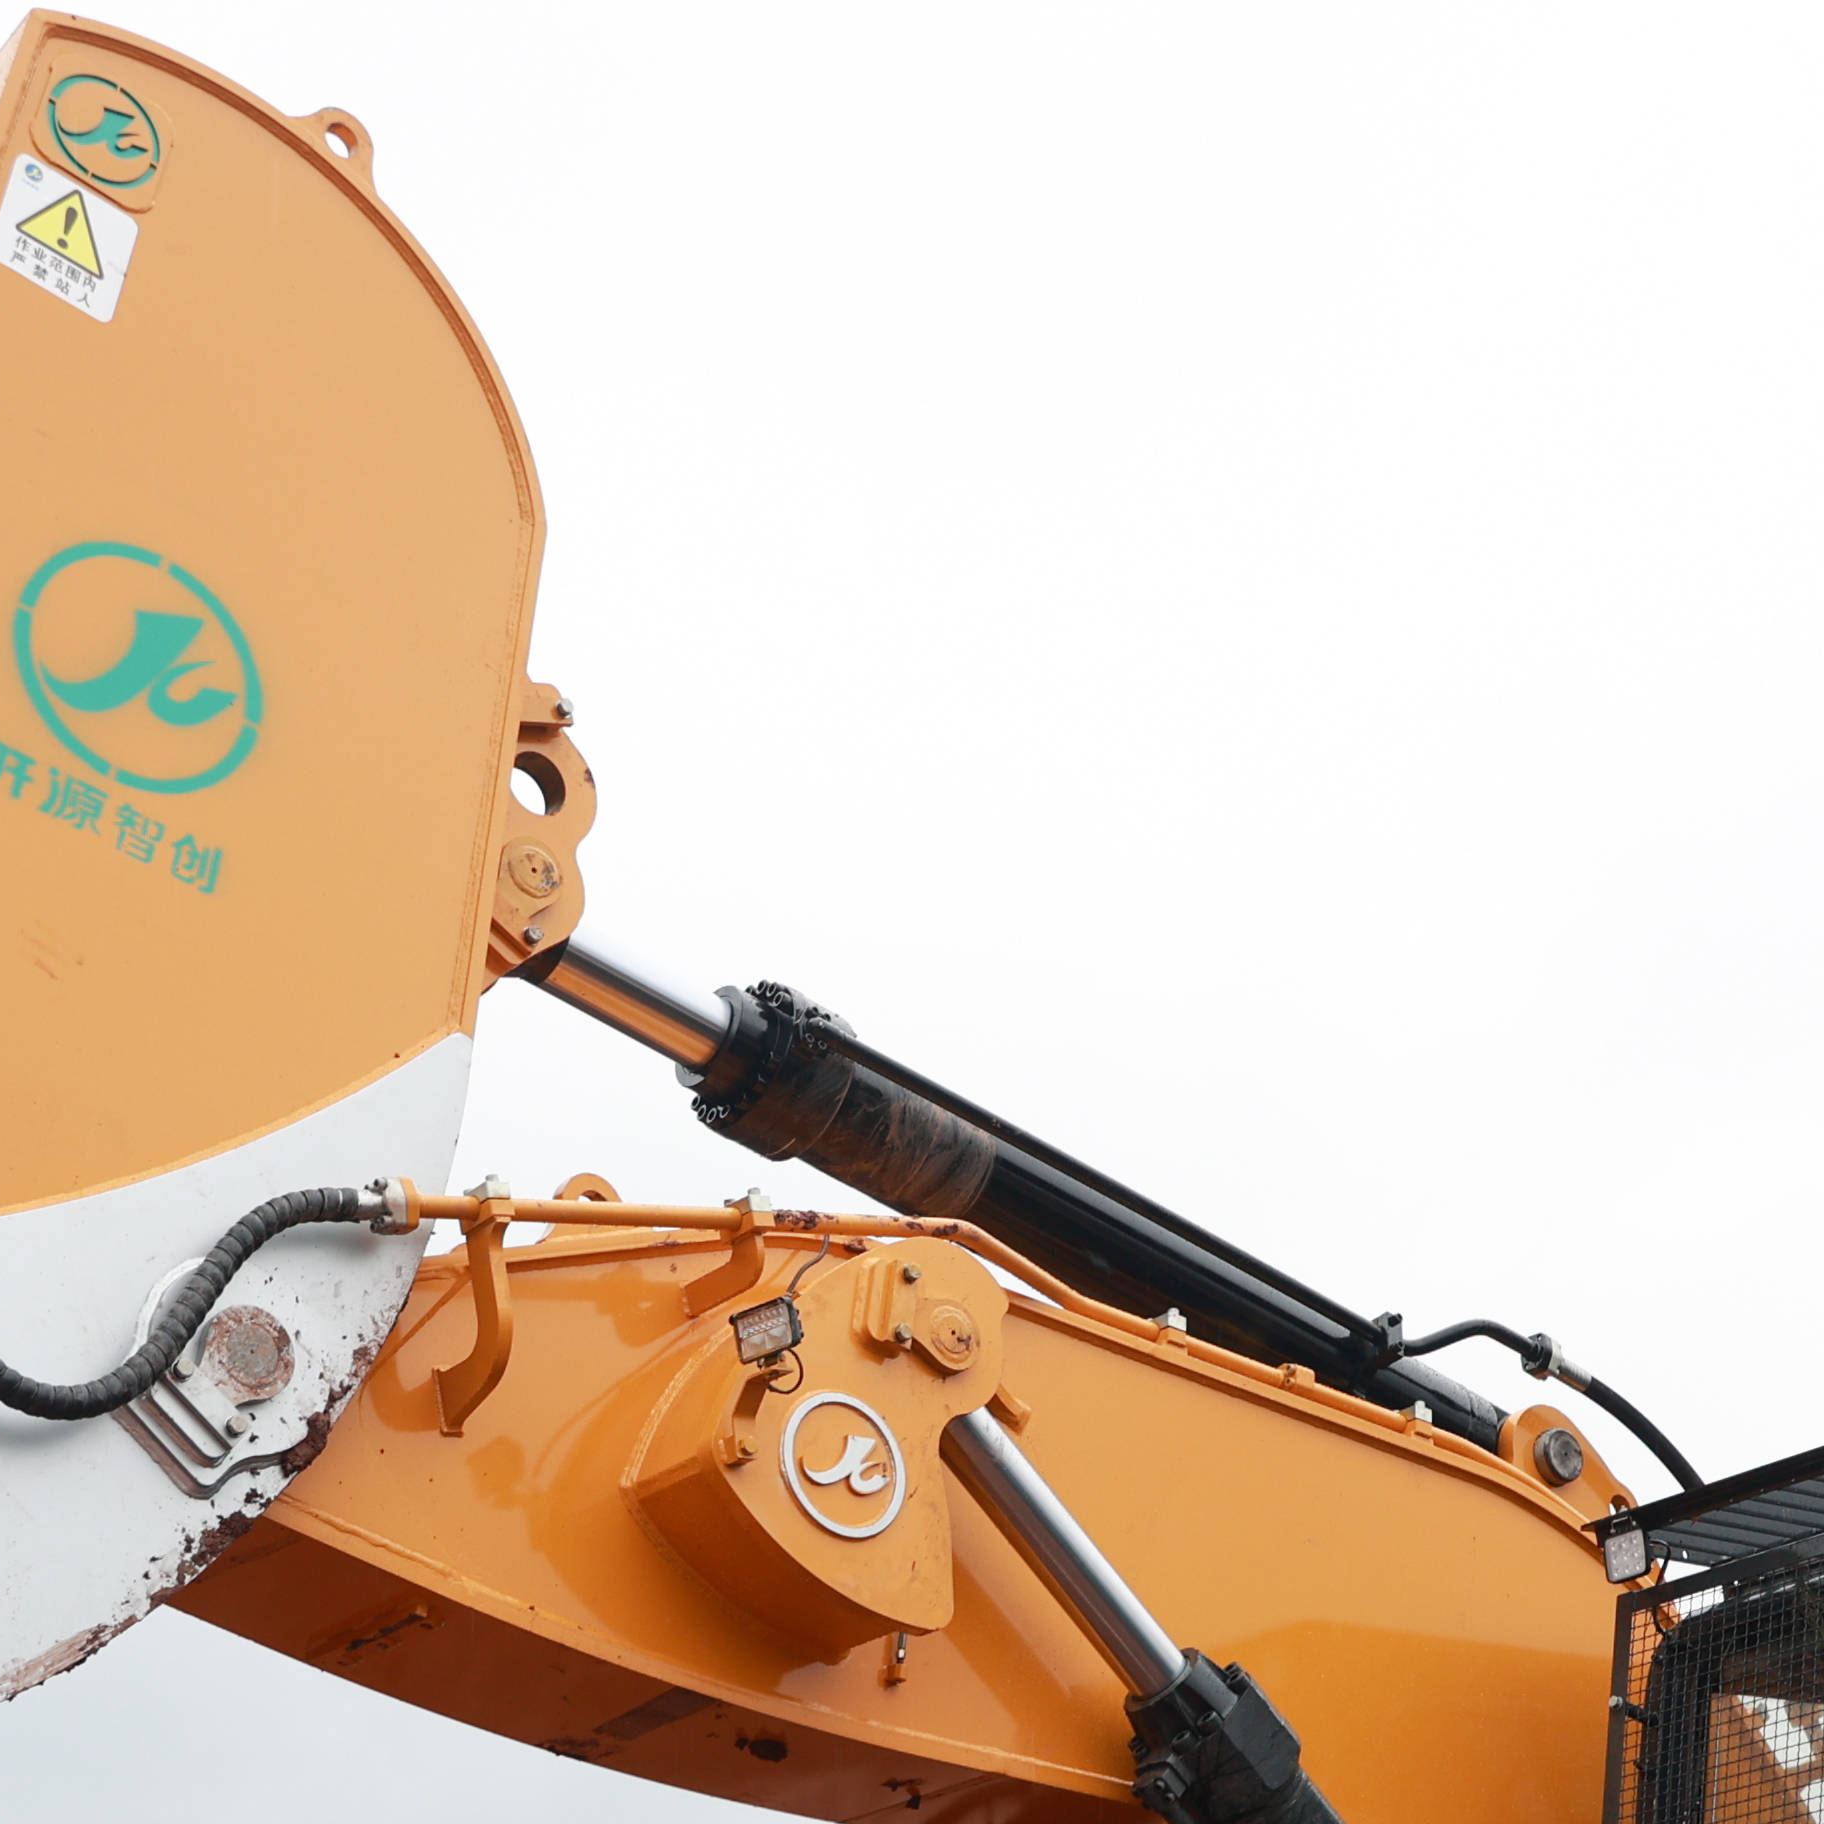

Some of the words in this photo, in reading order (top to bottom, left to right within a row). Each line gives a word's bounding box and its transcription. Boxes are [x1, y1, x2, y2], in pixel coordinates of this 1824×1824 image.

[15, 236, 97, 292] 作业范围内
